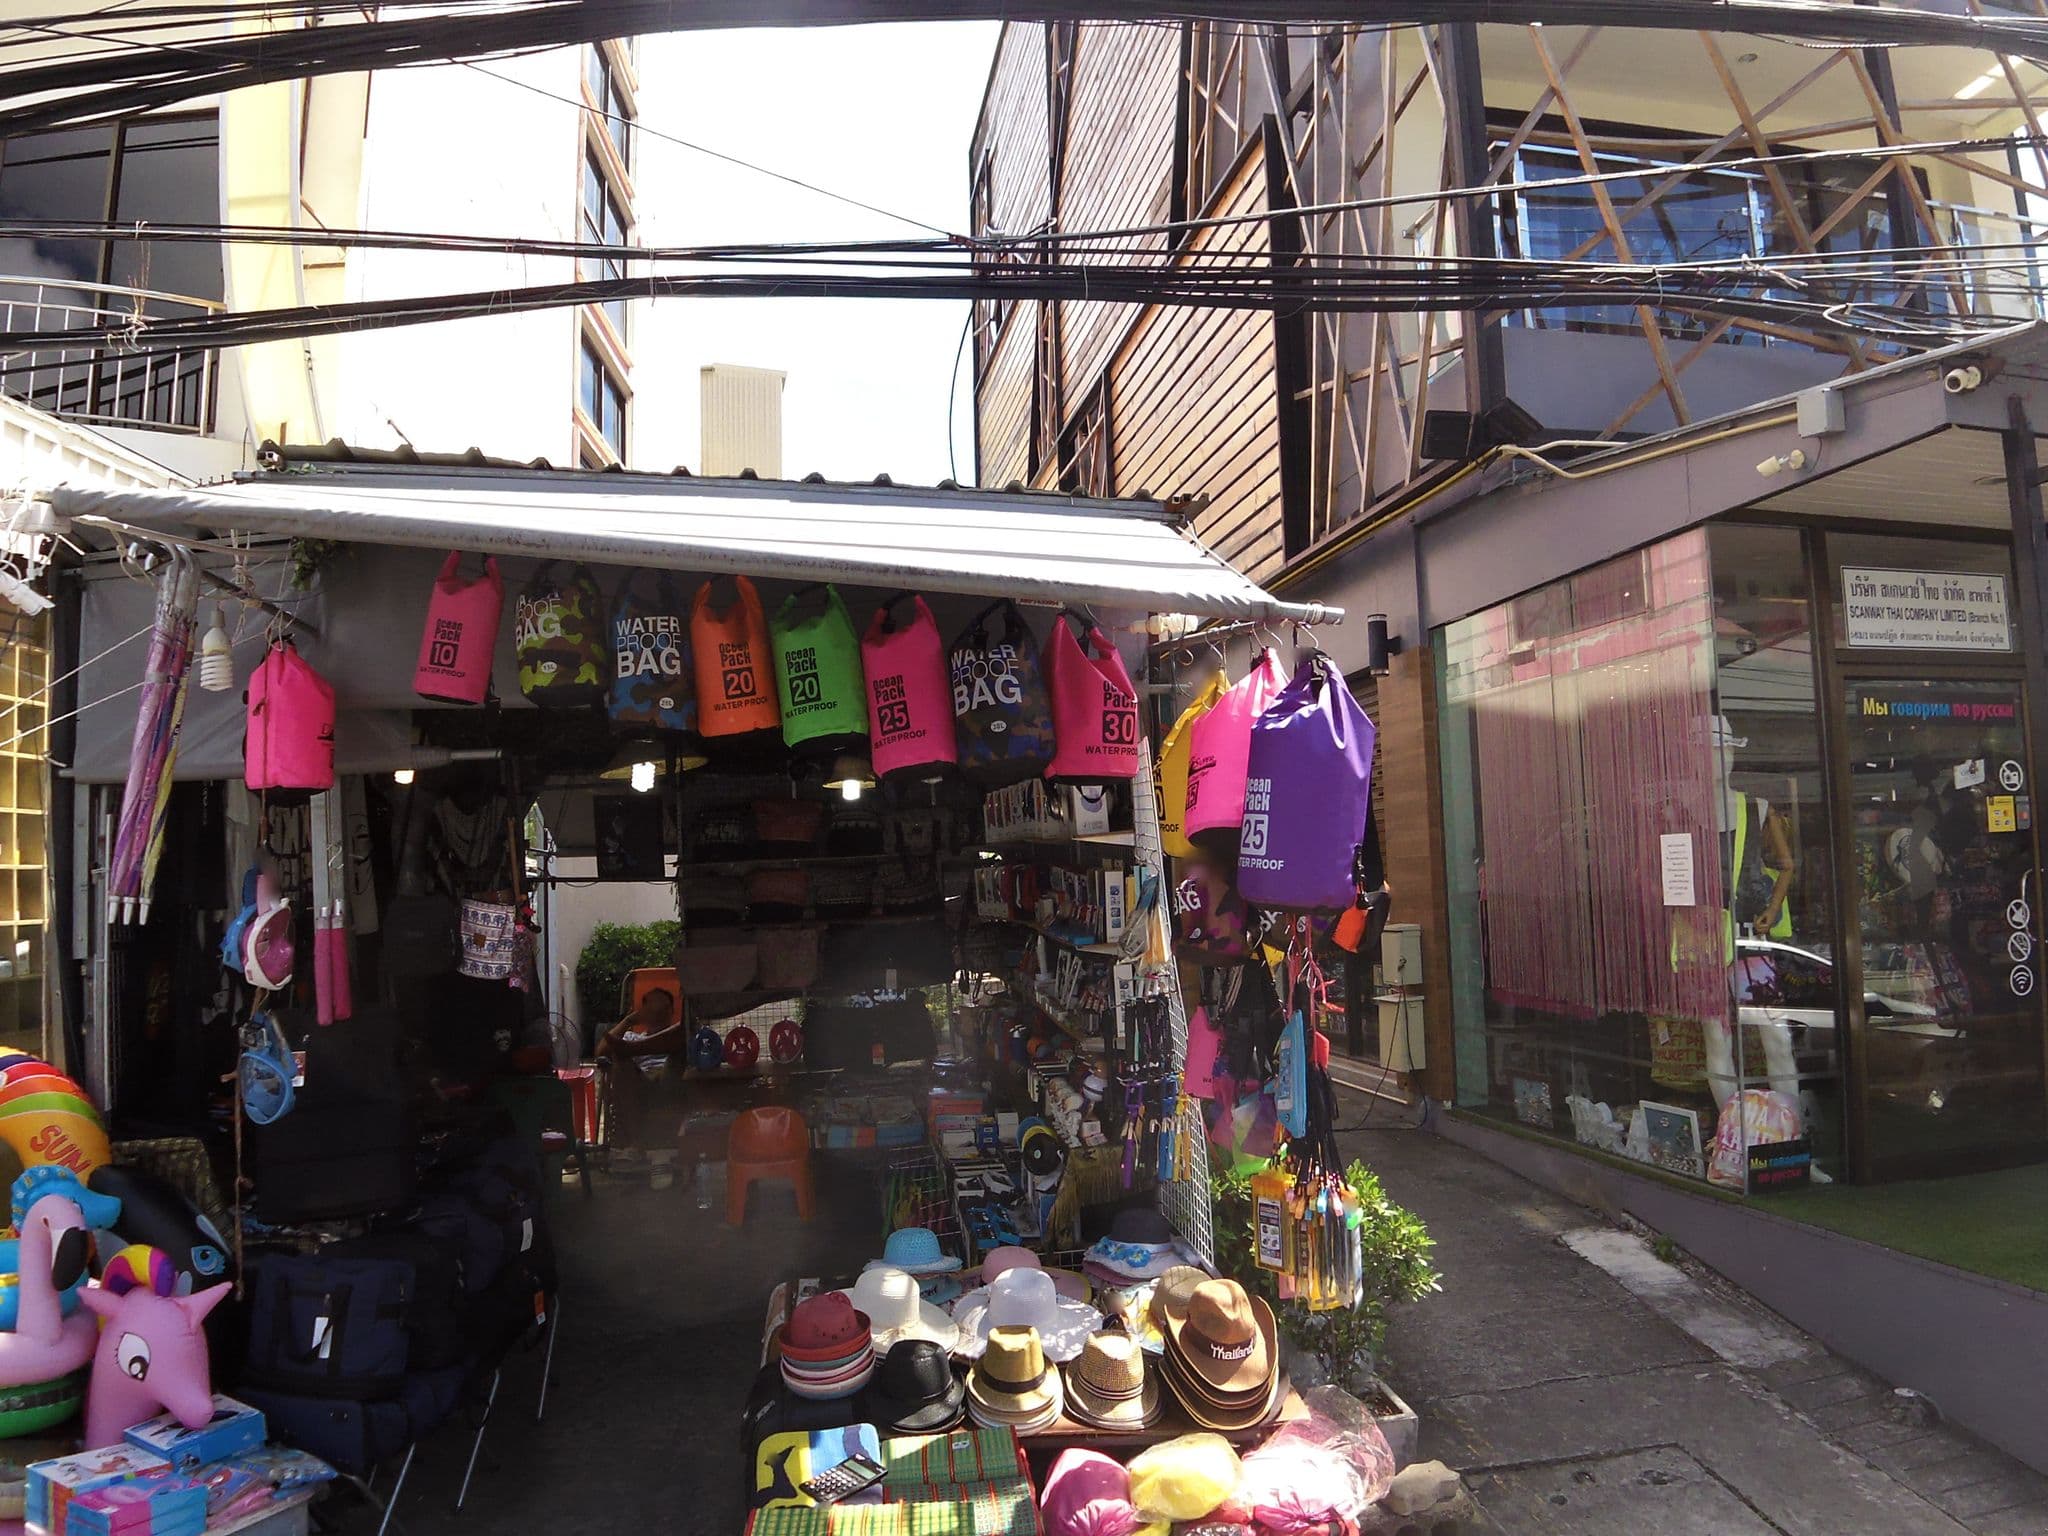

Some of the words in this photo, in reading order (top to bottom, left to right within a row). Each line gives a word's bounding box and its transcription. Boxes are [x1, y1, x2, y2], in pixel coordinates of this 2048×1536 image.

[616, 616, 680, 637] WATER
[1849, 605, 1885, 620] SCANWAY
[1886, 607, 1903, 621] THAI
[1905, 607, 1938, 622] COMPANY
[1940, 609, 1966, 624] LIMITED
[515, 612, 562, 652] BAG
[616, 632, 681, 652] PROOF
[617, 647, 681, 679] BAG
[951, 644, 1017, 671] WATER
[726, 671, 753, 696] 20
[952, 659, 1020, 689] PROOF
[792, 677, 818, 703] 20
[954, 674, 1023, 717] BAG
[881, 704, 908, 732] 25
[1863, 698, 1889, 716] Мы
[1890, 703, 1950, 720] говорим
[1105, 713, 1134, 742] 30
[1241, 819, 1265, 850] 25
[1173, 891, 1202, 916] BAG
[30, 1124, 93, 1175] SUN
[1210, 1337, 1254, 1360] Thailand
